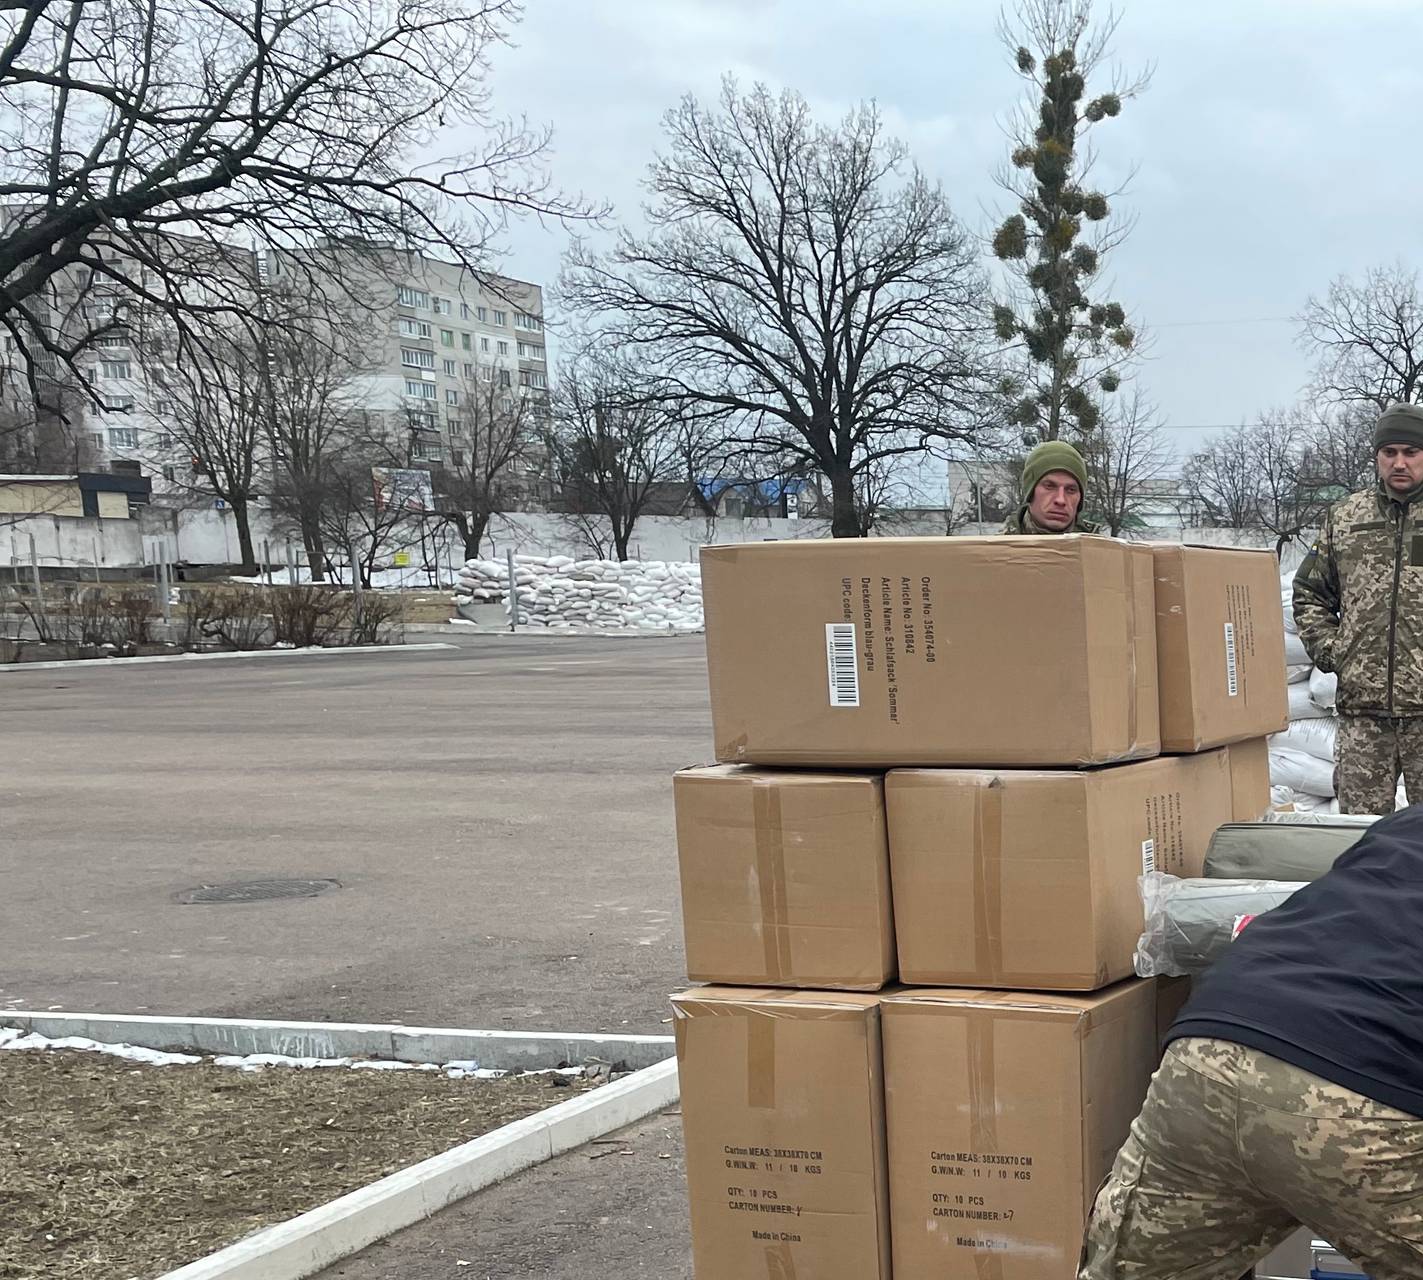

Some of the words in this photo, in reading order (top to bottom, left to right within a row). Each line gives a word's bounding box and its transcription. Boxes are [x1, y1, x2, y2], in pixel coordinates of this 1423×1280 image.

[842, 578, 852, 596] UPC
[881, 577, 891, 605] Article
[901, 577, 911, 605] Article
[921, 577, 930, 601] Order
[843, 598, 853, 621] code:
[862, 578, 872, 628] Deckenform
[883, 608, 892, 634] Name:
[904, 624, 915, 654] 310842
[924, 620, 935, 662] 354074-00
[864, 631, 875, 671] blau-grau
[885, 637, 895, 682] Schlafsack
[724, 1146, 747, 1155] Carton
[750, 1147, 772, 1157] MEAS:
[810, 1151, 822, 1160] CM
[931, 1152, 955, 1161] Carton
[957, 1153, 981, 1163] MEAS:
[982, 1155, 1019, 1165] 38X38X70
[1020, 1157, 1032, 1166] CM
[765, 1162, 772, 1172] 11
[790, 1164, 798, 1172] 10
[805, 1165, 821, 1174] KGS
[973, 1168, 980, 1177] 11
[999, 1170, 1006, 1179] 10
[1014, 1171, 1031, 1180] KGS
[728, 1187, 744, 1196] QTY:
[750, 1189, 757, 1197] 10
[762, 1190, 777, 1199] PCS
[932, 1193, 949, 1203] QTY:
[955, 1195, 963, 1204] 10
[969, 1196, 984, 1206] PCS
[729, 1201, 758, 1212] CARTON
[760, 1204, 794, 1214] NUMBER:
[933, 1208, 964, 1218] CARTON
[966, 1210, 1001, 1221] NUMBER:
[752, 1230, 771, 1240] Made
[773, 1232, 779, 1240] in
[781, 1232, 801, 1242] China
[957, 1237, 975, 1247] Made
[977, 1240, 985, 1248] in
[986, 1240, 1008, 1248] China
